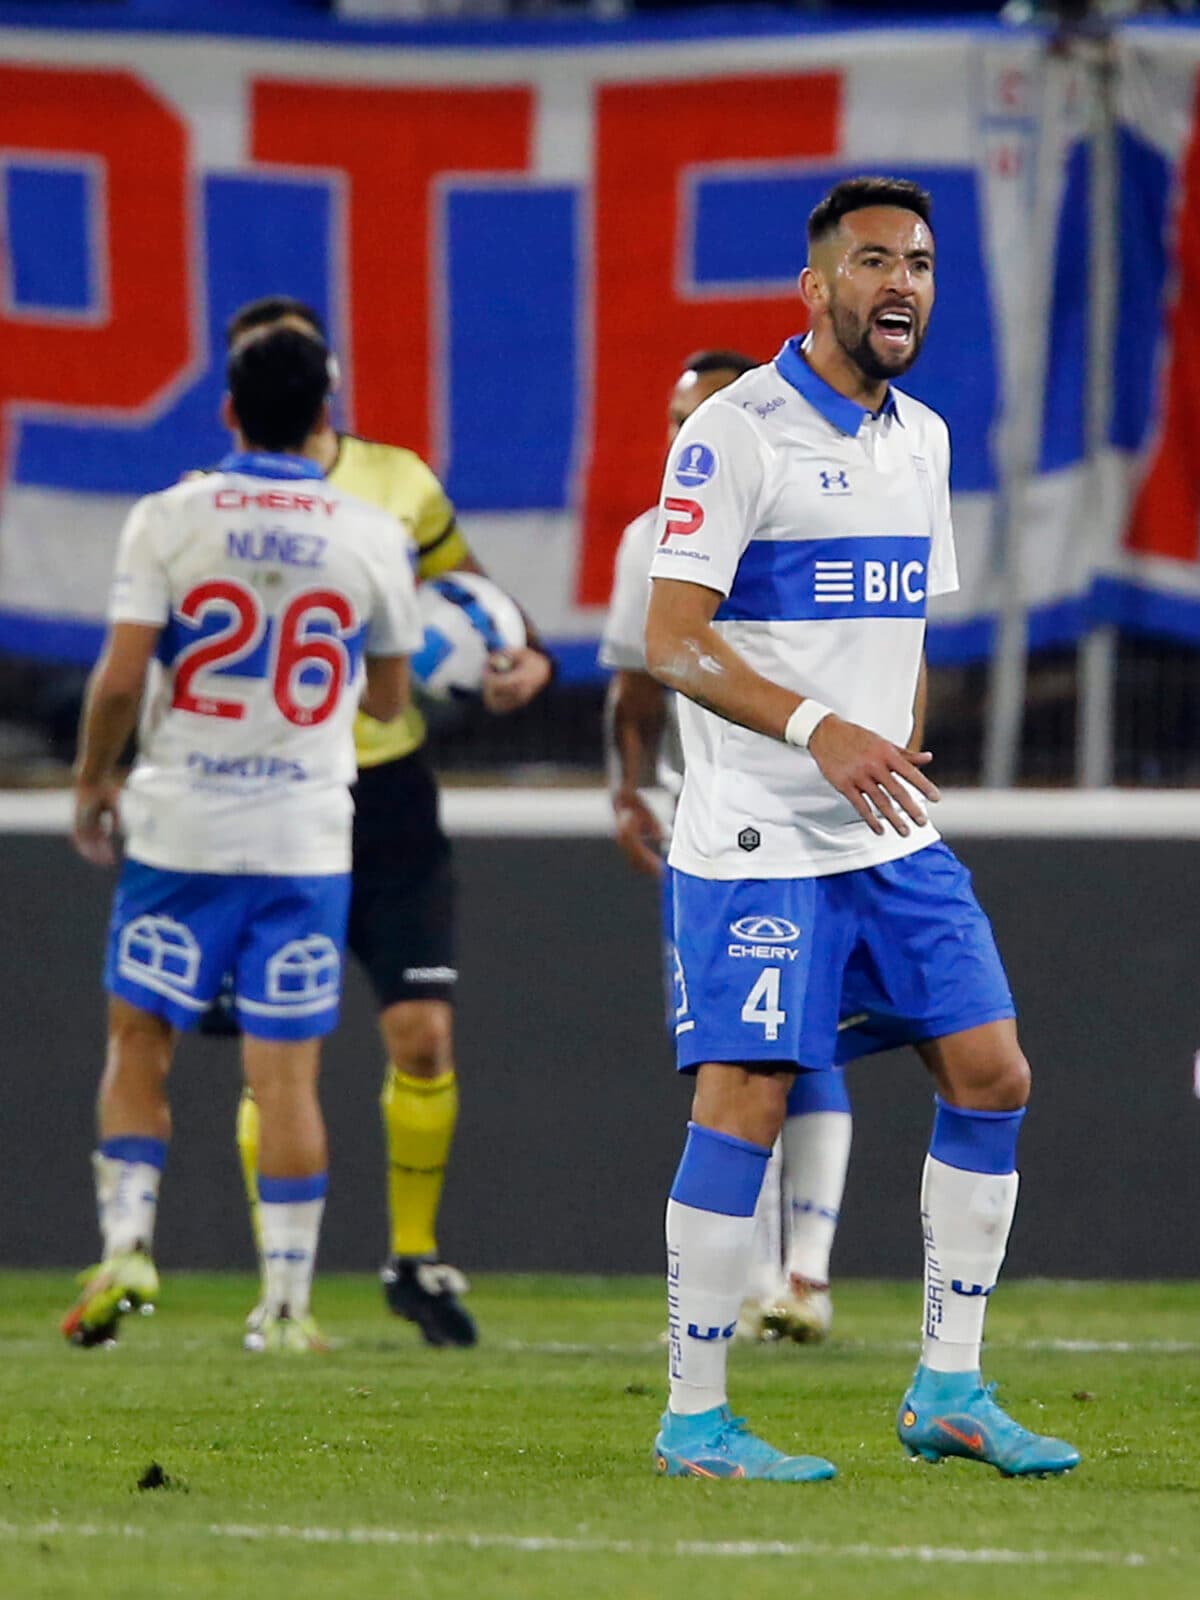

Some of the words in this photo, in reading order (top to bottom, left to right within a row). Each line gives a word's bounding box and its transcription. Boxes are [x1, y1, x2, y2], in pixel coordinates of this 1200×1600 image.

[215, 489, 340, 517] CHERY
[864, 560, 926, 603] BIC
[172, 579, 356, 727] 26
[728, 943, 799, 961] CHERY
[741, 966, 786, 1040] 4
